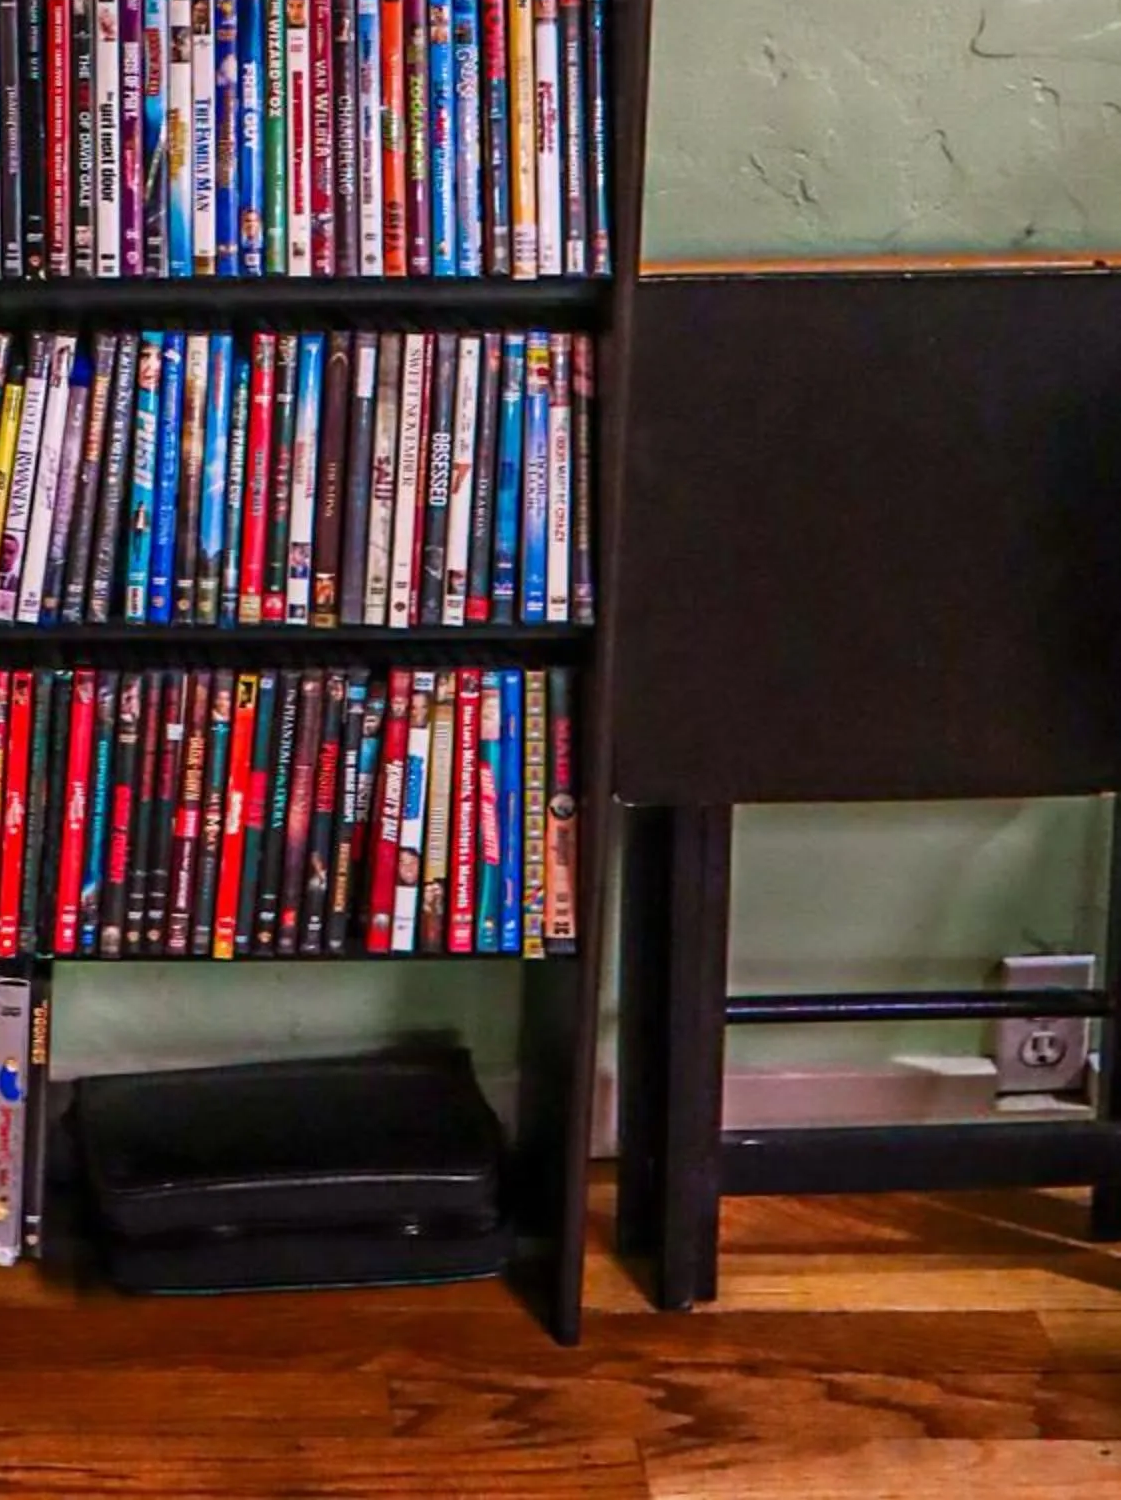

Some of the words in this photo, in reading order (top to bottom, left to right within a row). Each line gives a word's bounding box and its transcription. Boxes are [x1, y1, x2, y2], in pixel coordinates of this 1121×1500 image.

[78, 54, 90, 78] THE
[268, 19, 281, 80] WIZARD
[243, 62, 256, 109] FREE
[314, 59, 326, 88] VAN
[79, 111, 90, 129] OF
[244, 112, 256, 148] GUY
[79, 133, 91, 170] DAVID
[195, 127, 211, 175] FAMILY
[337, 95, 352, 196] CHANGELING
[79, 174, 92, 208] GALE
[101, 168, 117, 203] door
[196, 177, 212, 212] MAN
[406, 348, 422, 398] SWEET
[401, 404, 418, 487] NOVEMBER
[10, 450, 34, 518] RWANDA
[429, 433, 449, 506] OBSESSED
[32, 1007, 46, 1064] GOONIES
